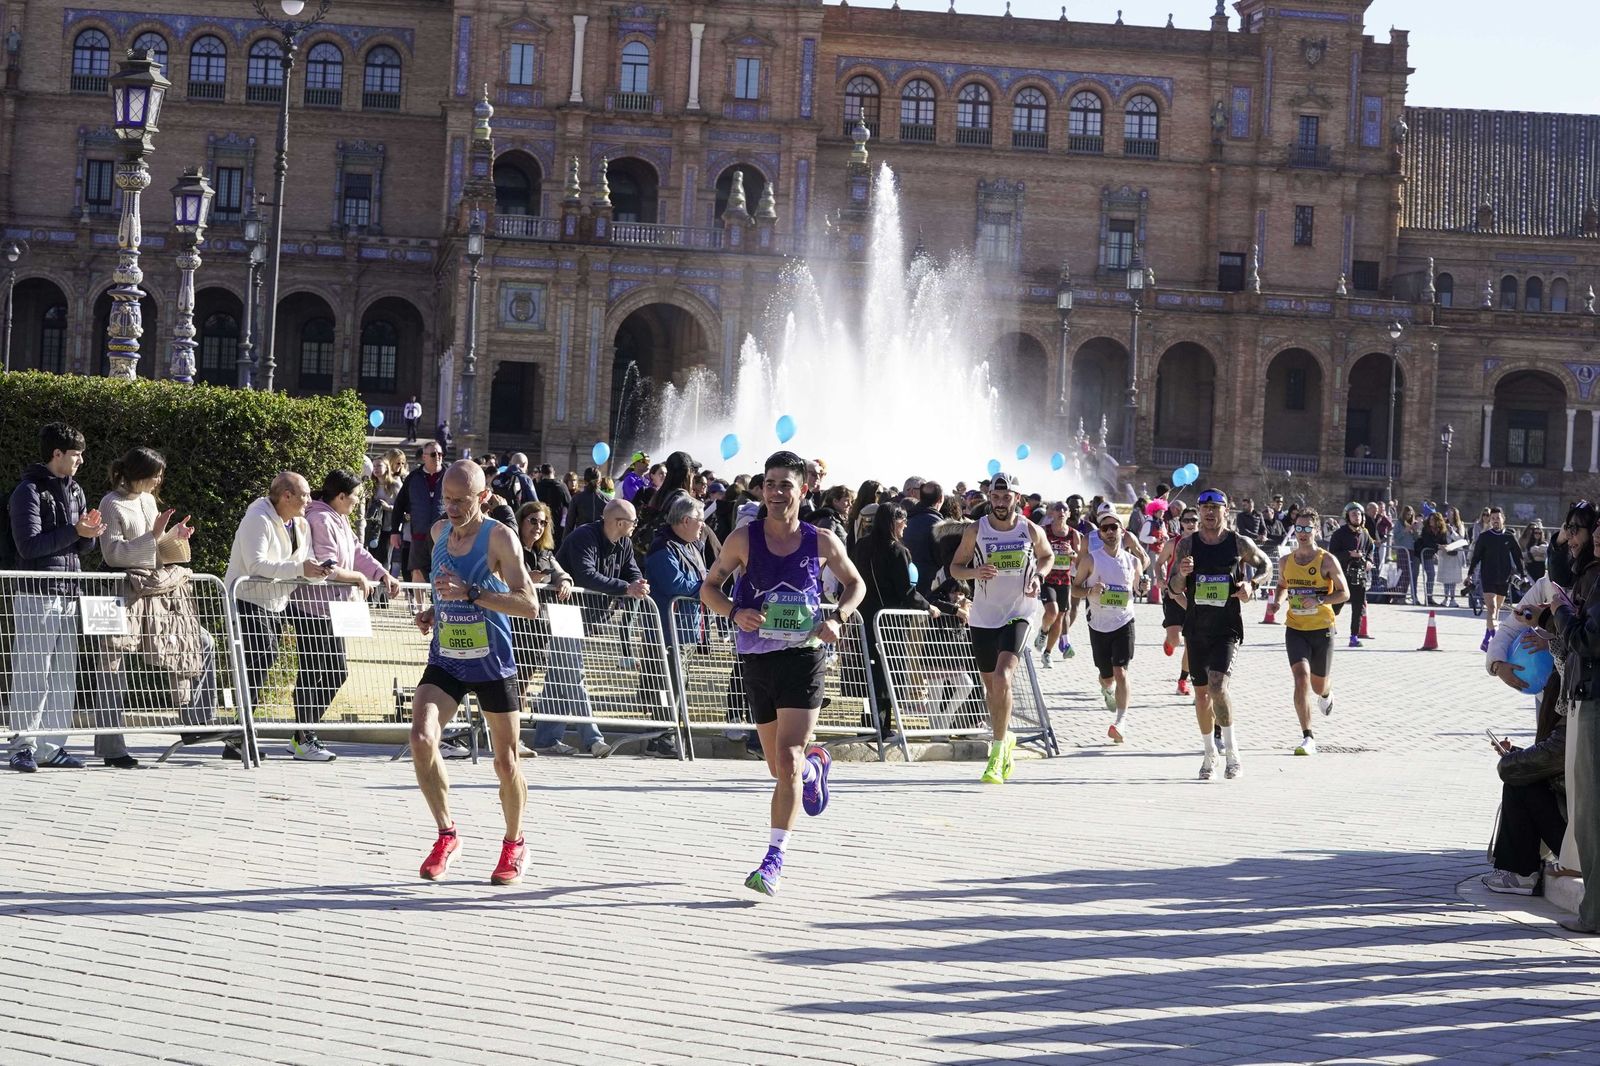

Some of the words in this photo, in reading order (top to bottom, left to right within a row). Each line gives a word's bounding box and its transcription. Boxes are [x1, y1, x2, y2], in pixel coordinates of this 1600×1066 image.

[993, 560, 1021, 569] FLORES
[92, 601, 118, 617] AMS
[782, 608, 796, 616] 597
[449, 614, 478, 622] ZURICH
[773, 617, 802, 630] TIGRE
[452, 628, 467, 636] 1915
[448, 637, 474, 648] GREG
